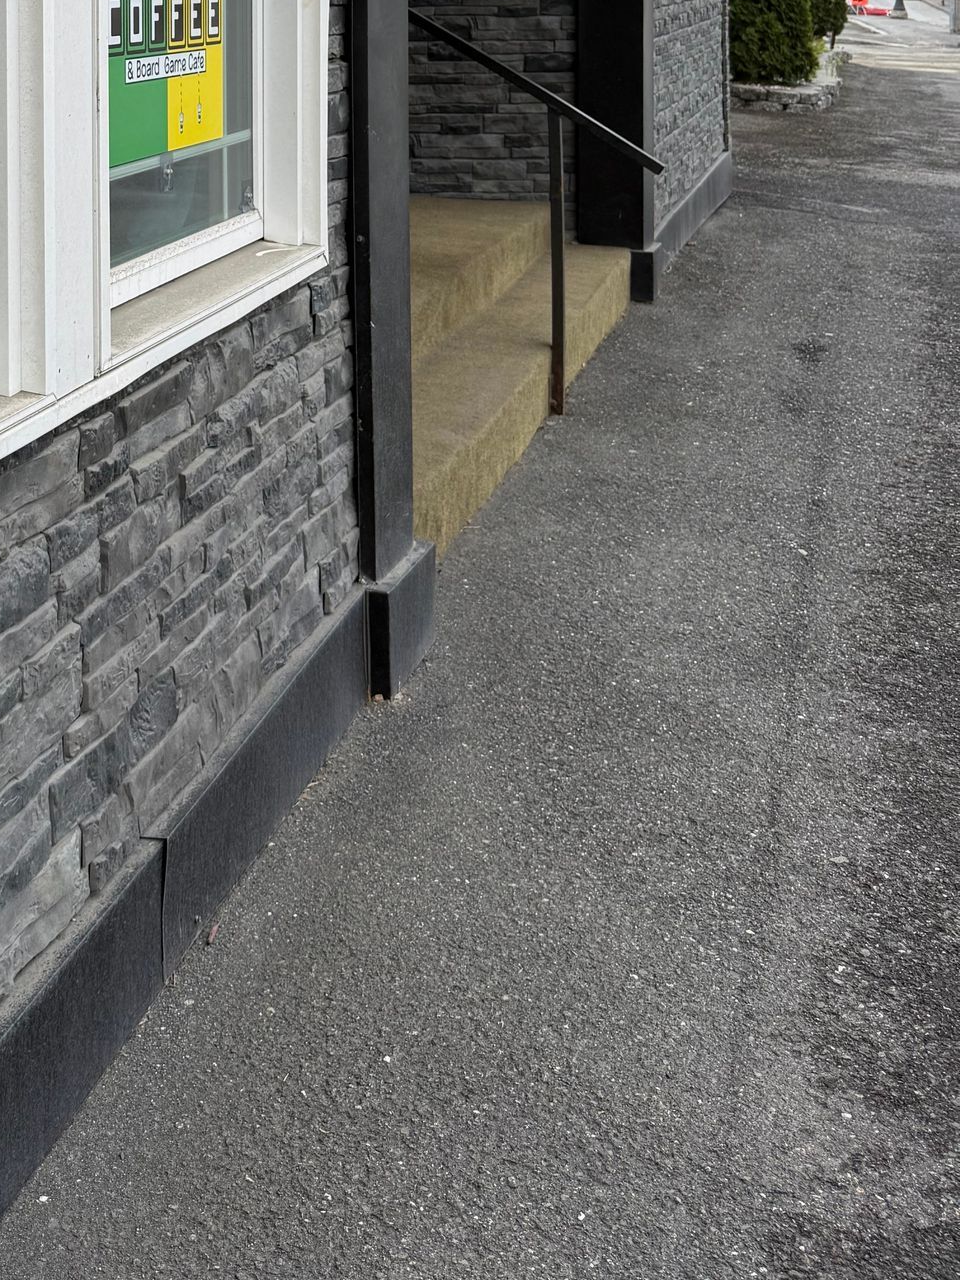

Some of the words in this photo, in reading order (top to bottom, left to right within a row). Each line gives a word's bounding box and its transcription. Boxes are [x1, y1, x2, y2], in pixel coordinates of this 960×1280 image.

[127, 60, 134, 80] &
[136, 57, 160, 79] Board
[163, 55, 187, 75] Game
[188, 51, 205, 71] Cafe
